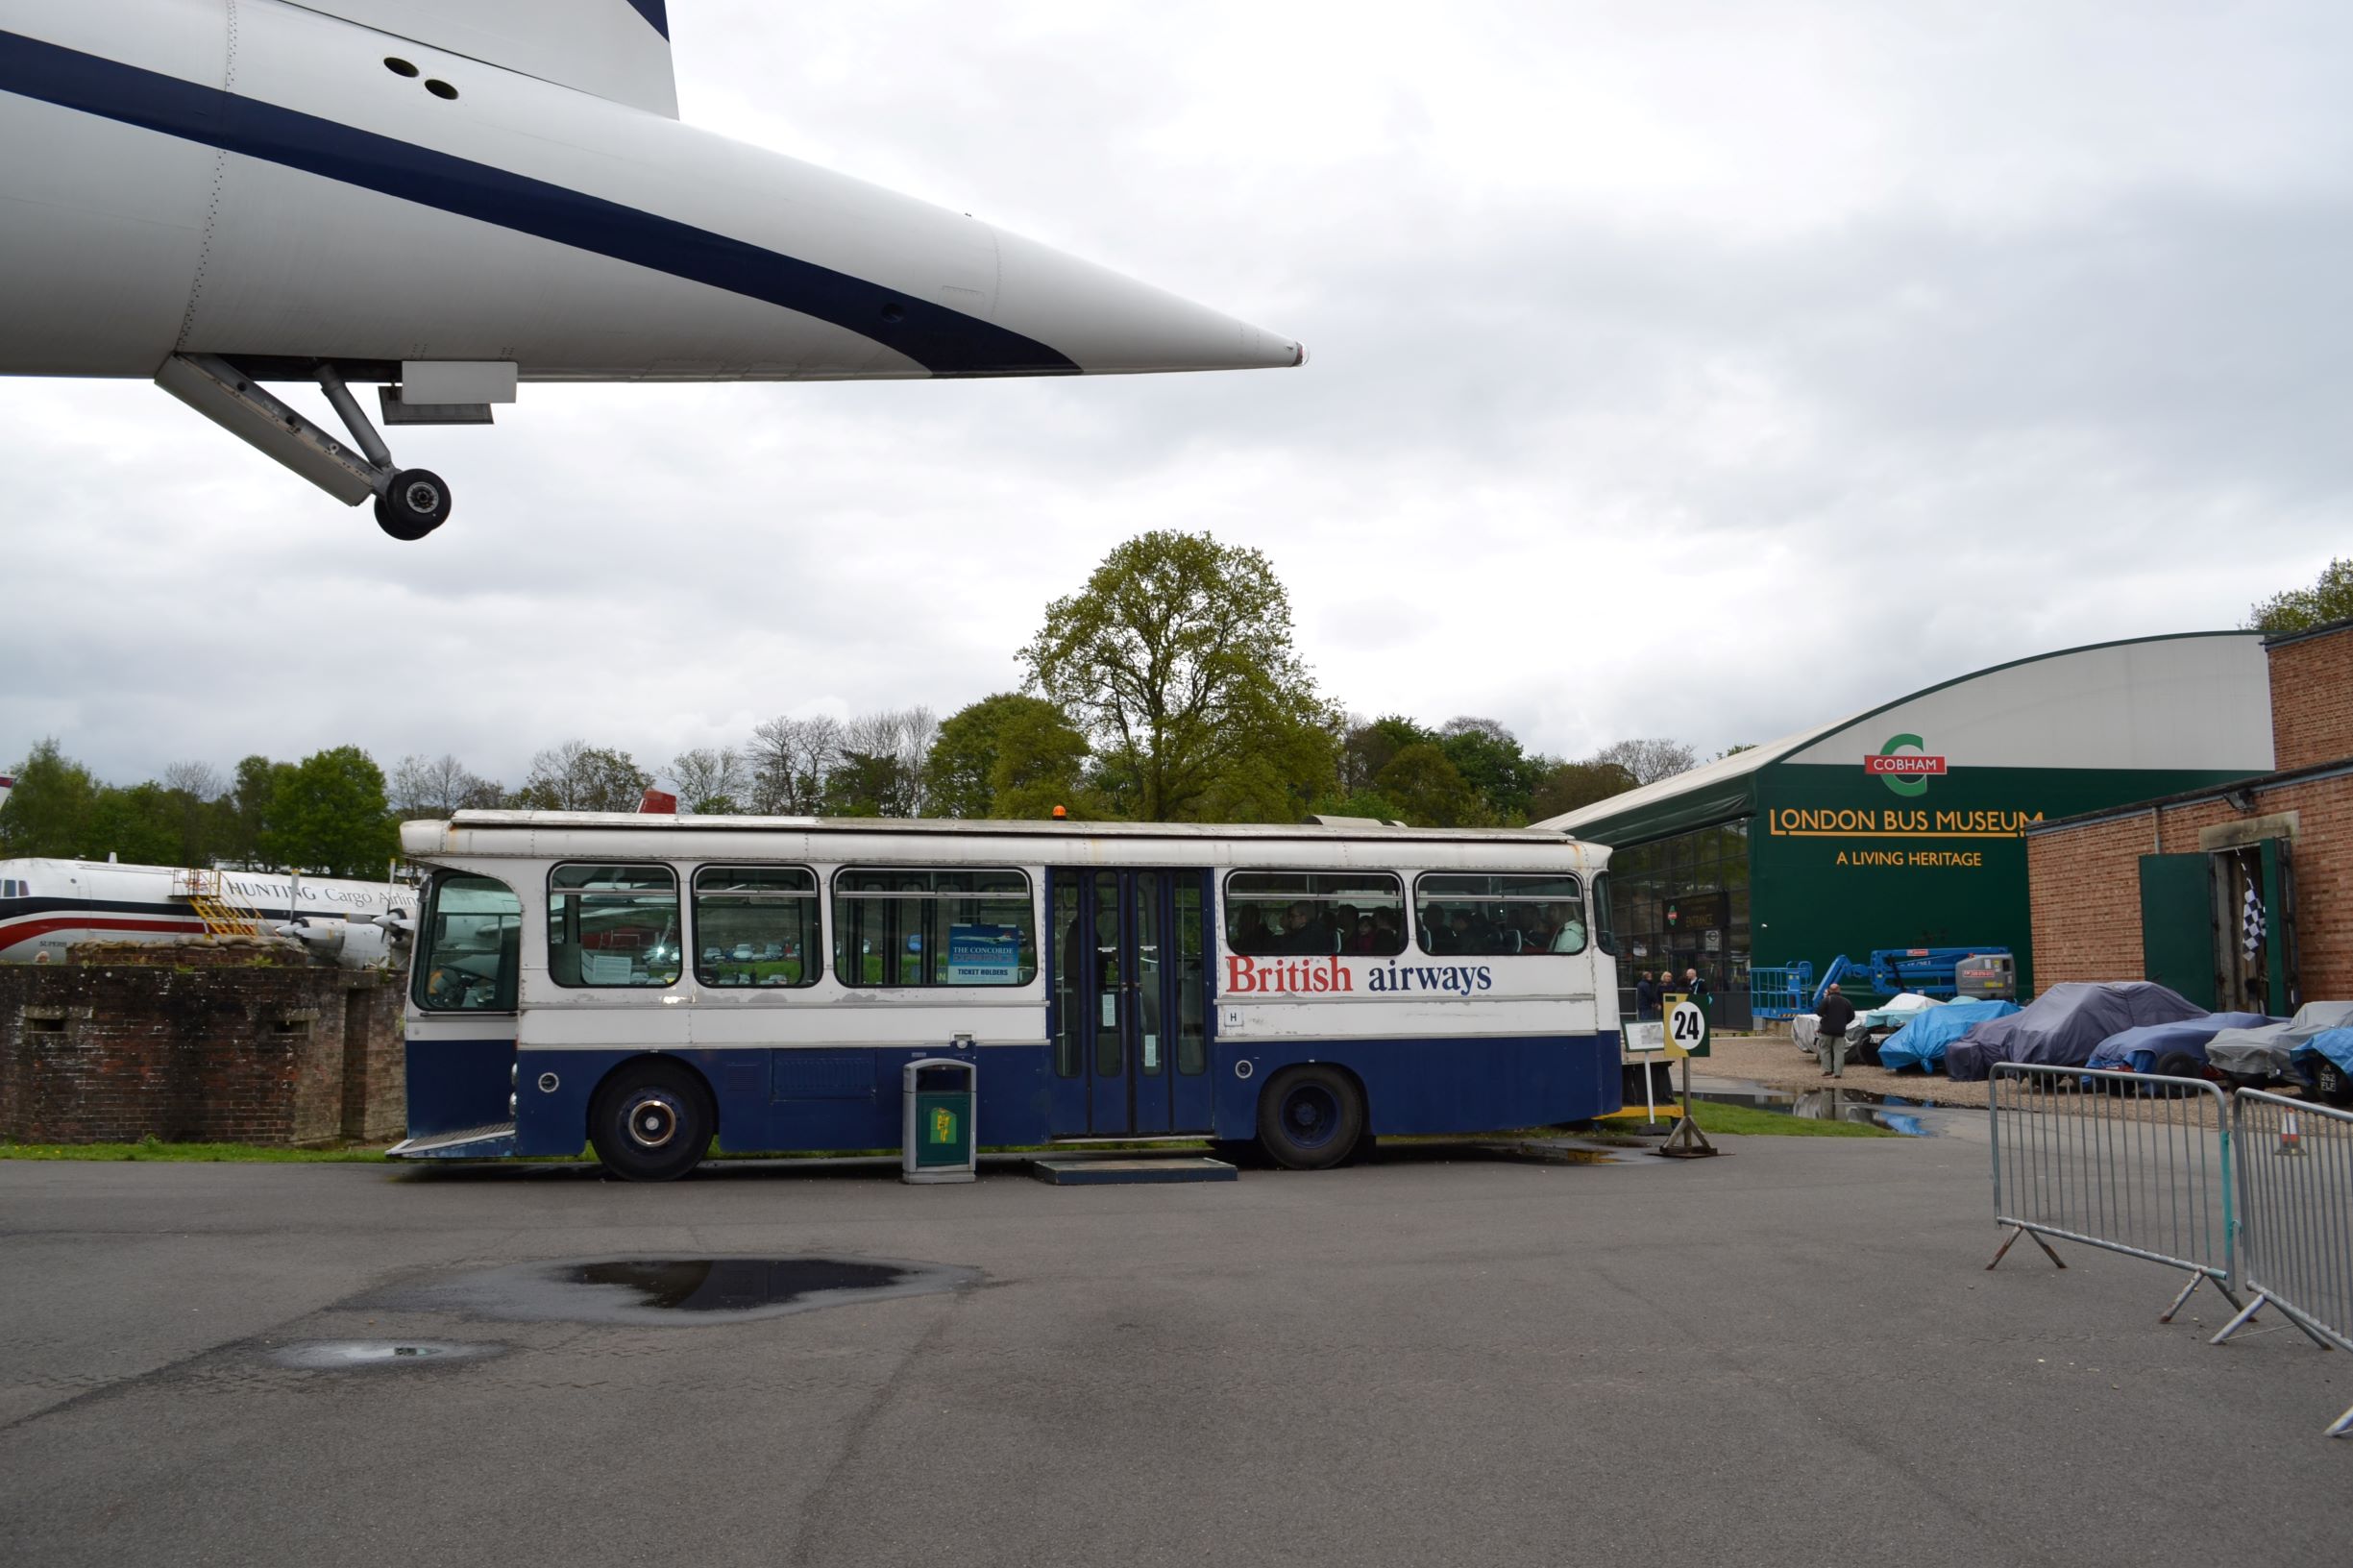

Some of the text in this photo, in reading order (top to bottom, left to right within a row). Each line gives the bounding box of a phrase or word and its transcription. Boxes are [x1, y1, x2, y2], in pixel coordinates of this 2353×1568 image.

[1874, 759, 1937, 771] COBHAM
[1770, 809, 2044, 836] LONDON BUS MUSEUM
[1836, 851, 1982, 867] A LIVING HERITAGE
[325, 889, 373, 907] Cargo
[379, 892, 417, 907] Airlin
[1225, 954, 1492, 996] British airways
[1230, 1013, 1238, 1022] H
[1674, 1011, 1700, 1040] 24
